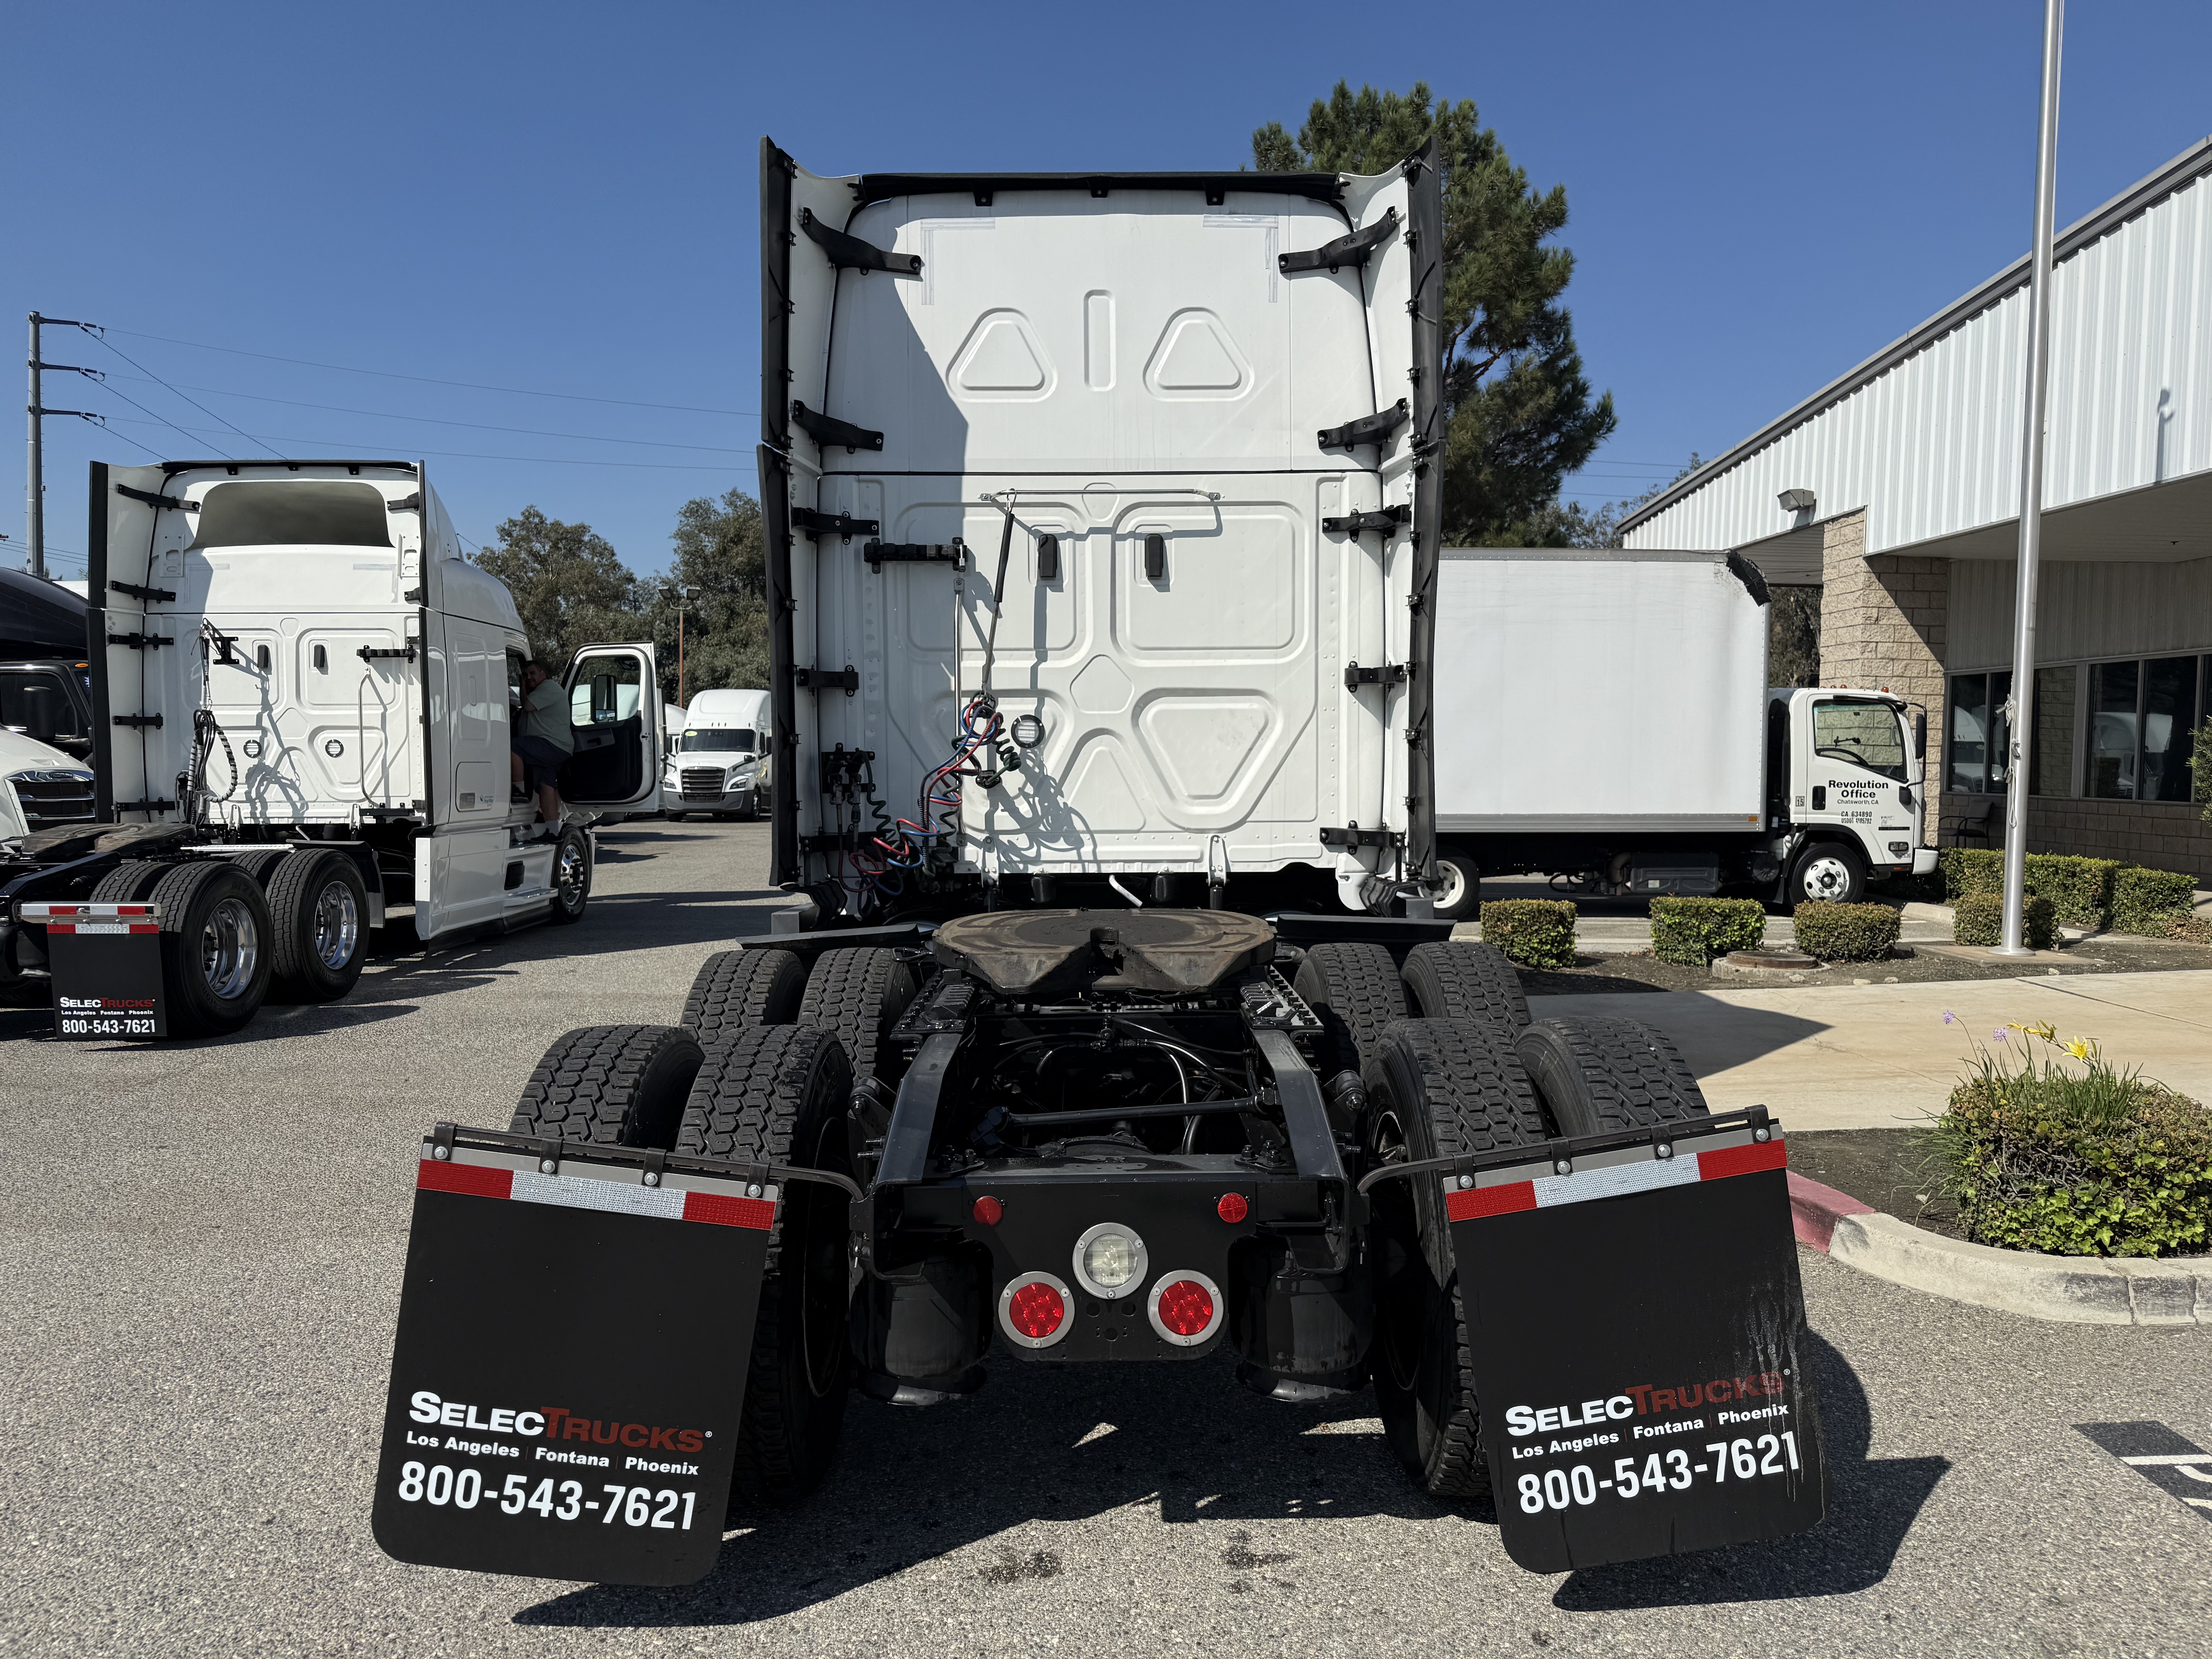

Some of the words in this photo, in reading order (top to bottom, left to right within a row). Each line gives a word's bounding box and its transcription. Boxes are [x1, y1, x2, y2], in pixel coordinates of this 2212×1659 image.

[1828, 780, 1889, 789] Revolution
[1841, 789, 1876, 798] Office
[62, 1019, 155, 1033] 800-543-7621
[407, 1431, 439, 1448] Los
[445, 1436, 519, 1458] Angeles
[535, 1447, 609, 1467] Fontana
[625, 1456, 699, 1476] Phoenix
[1512, 1445, 1544, 1459] Los
[1549, 1432, 1620, 1454] Angeles
[1634, 1419, 1704, 1439] Fontana
[1718, 1403, 1789, 1425] Phoenix
[1518, 1431, 1800, 1514] 800-543-7621
[398, 1461, 696, 1530] 800-543-7621
